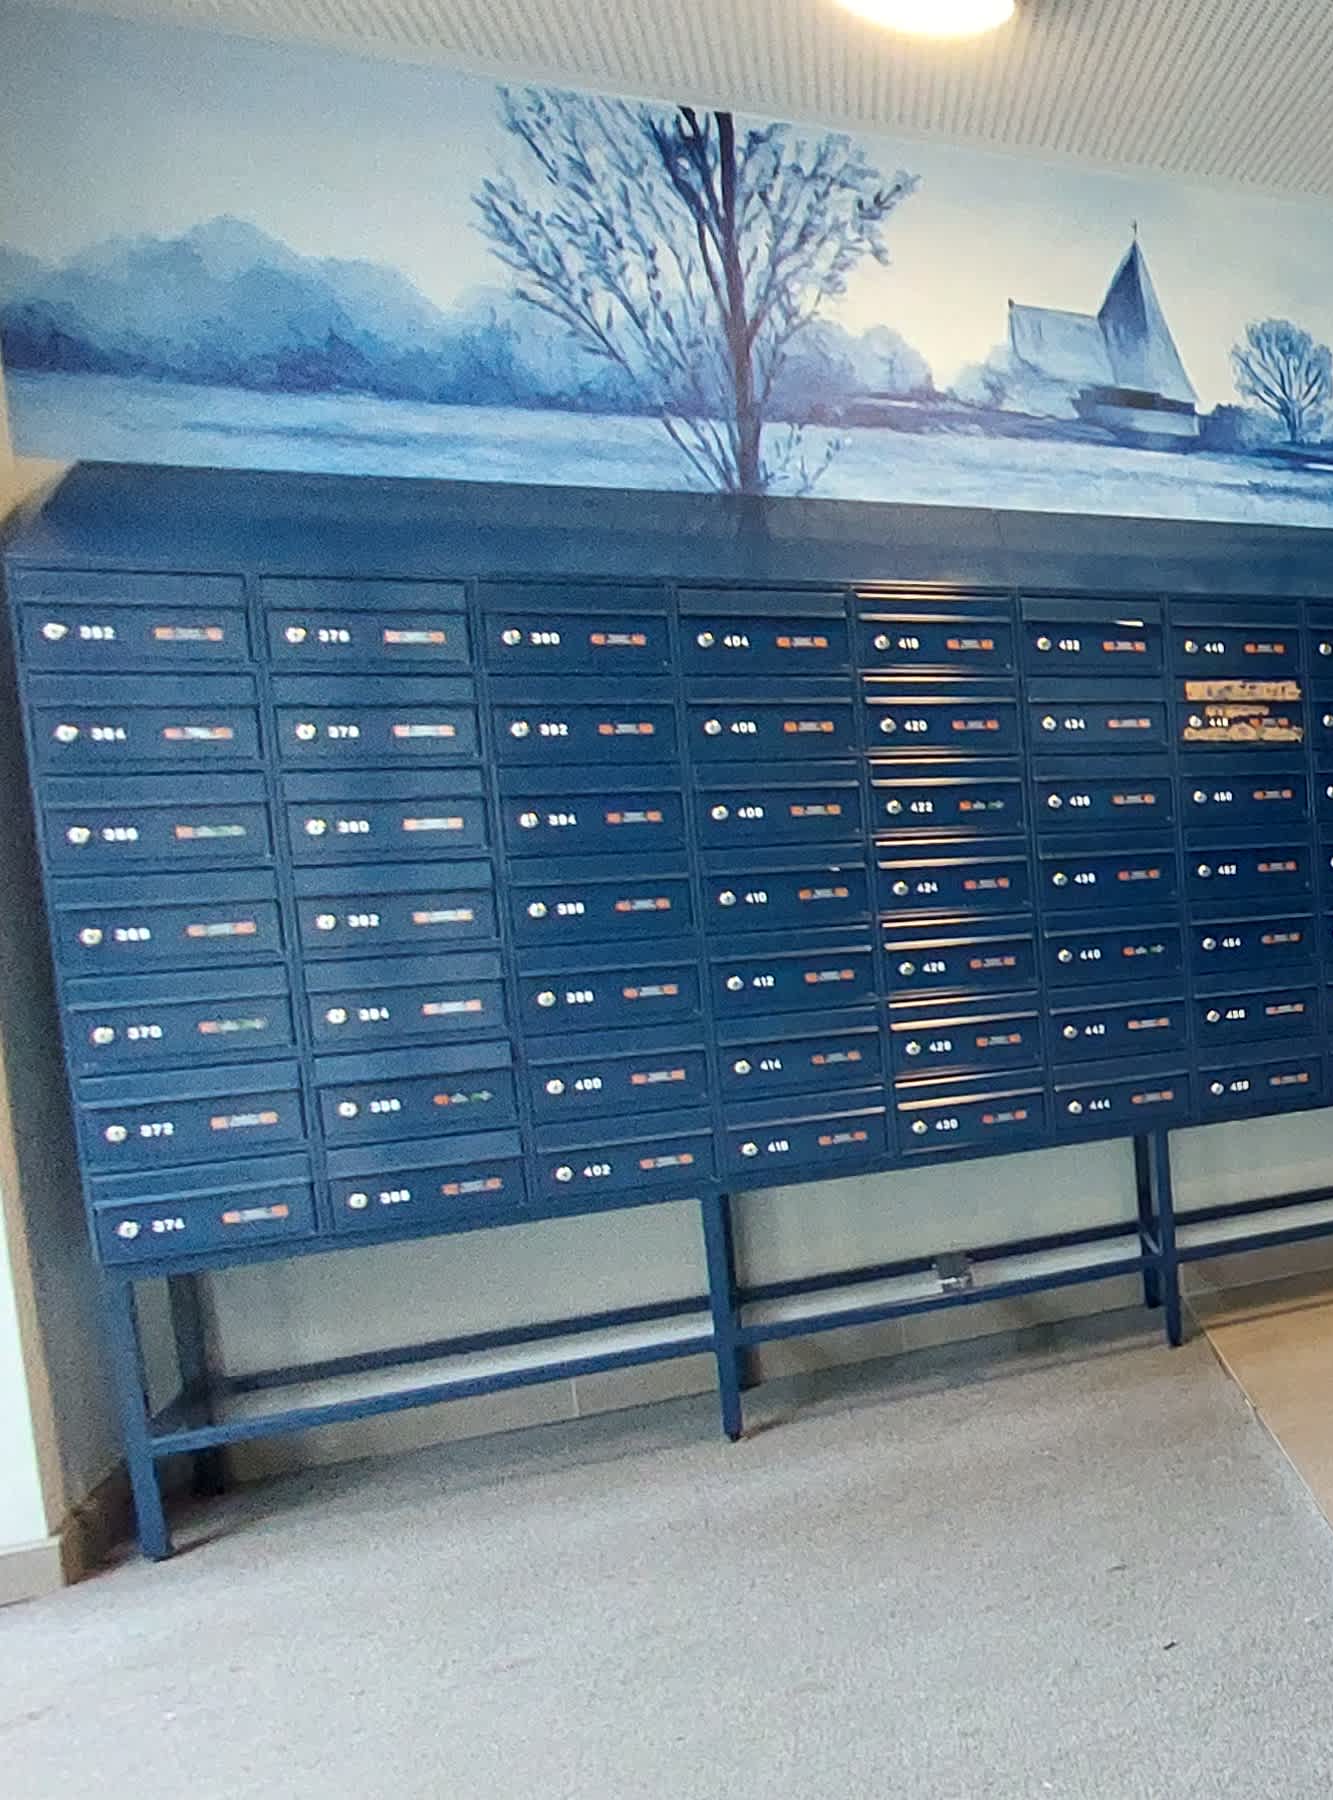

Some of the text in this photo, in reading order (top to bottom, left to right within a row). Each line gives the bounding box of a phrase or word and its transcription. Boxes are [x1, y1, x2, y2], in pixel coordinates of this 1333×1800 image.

[724, 636, 749, 647] 404
[904, 720, 927, 731] 420
[1065, 719, 1085, 729] 434
[911, 802, 932, 812] 422
[917, 882, 938, 893] 424
[745, 892, 767, 903] 410
[1080, 949, 1100, 959] 440
[753, 976, 774, 987] 412
[1085, 1024, 1104, 1035] 442
[760, 1059, 781, 1070] 414
[1090, 1100, 1110, 1109] 444
